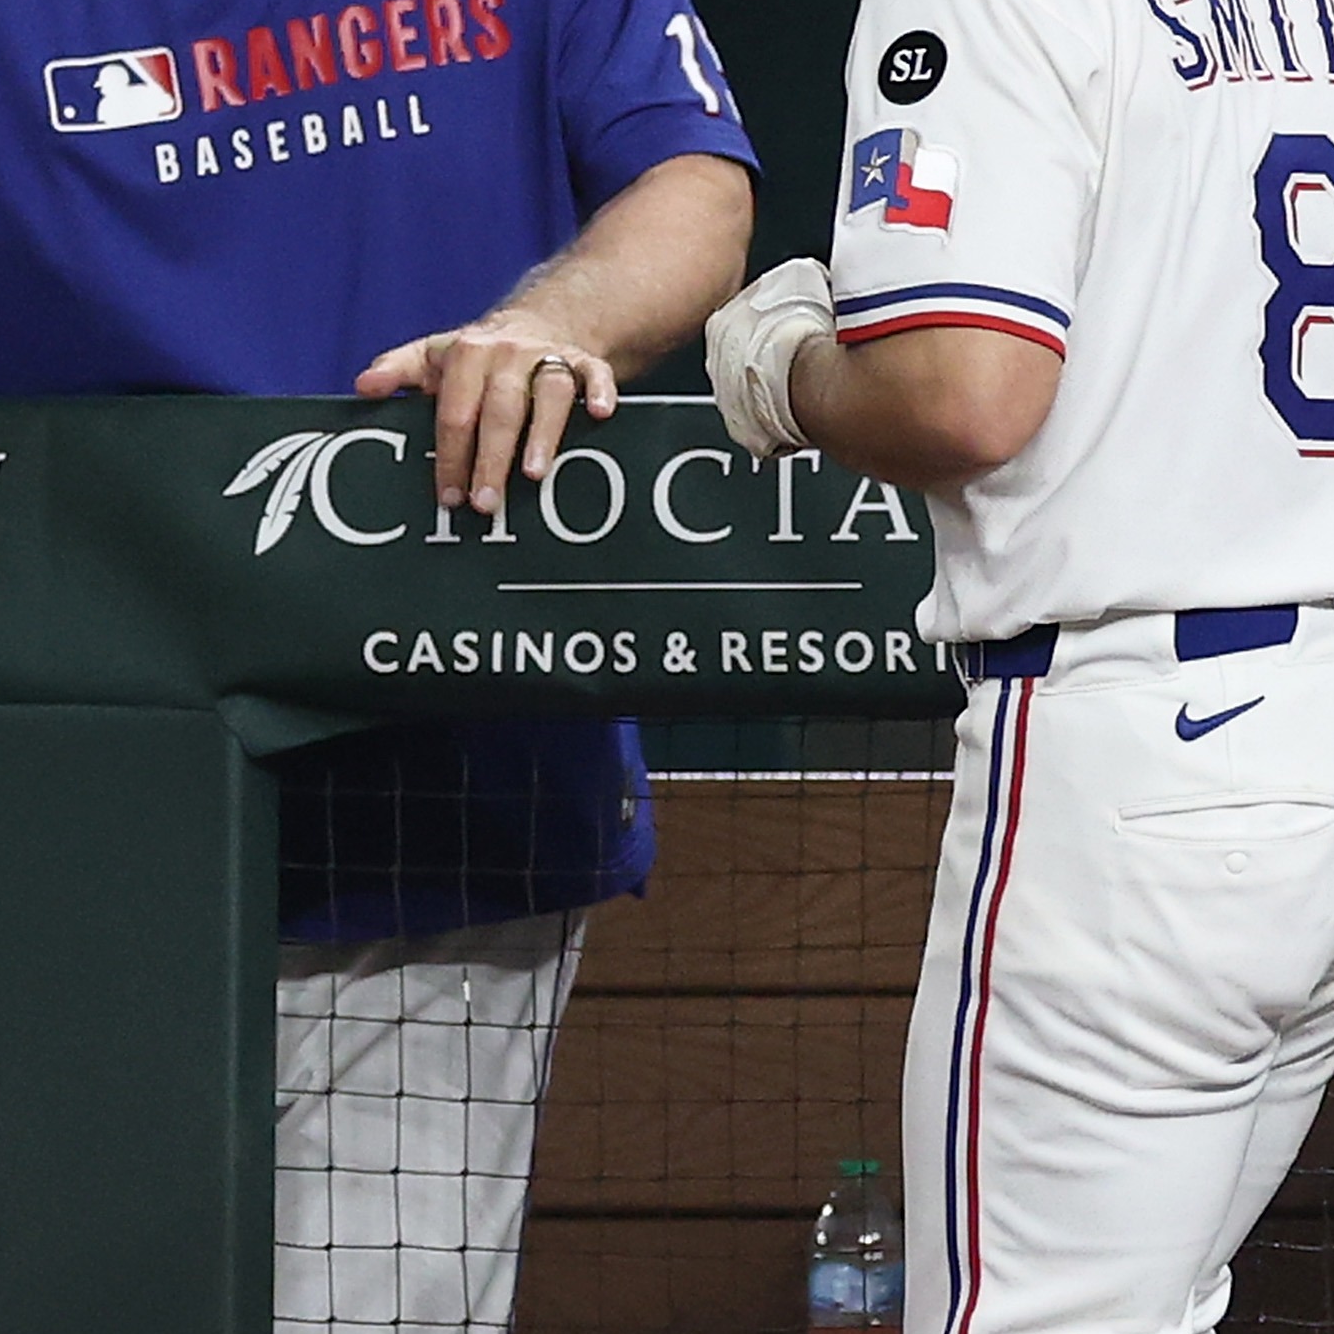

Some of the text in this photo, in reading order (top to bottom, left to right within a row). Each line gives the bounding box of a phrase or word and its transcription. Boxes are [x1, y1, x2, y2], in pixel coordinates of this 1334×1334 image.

[665, 13, 742, 125] 1
[890, 47, 933, 85] SL
[154, 94, 431, 184] BASEBALL
[309, 428, 920, 546] COCTA
[363, 631, 637, 673] CASINOS
[662, 631, 698, 673] &
